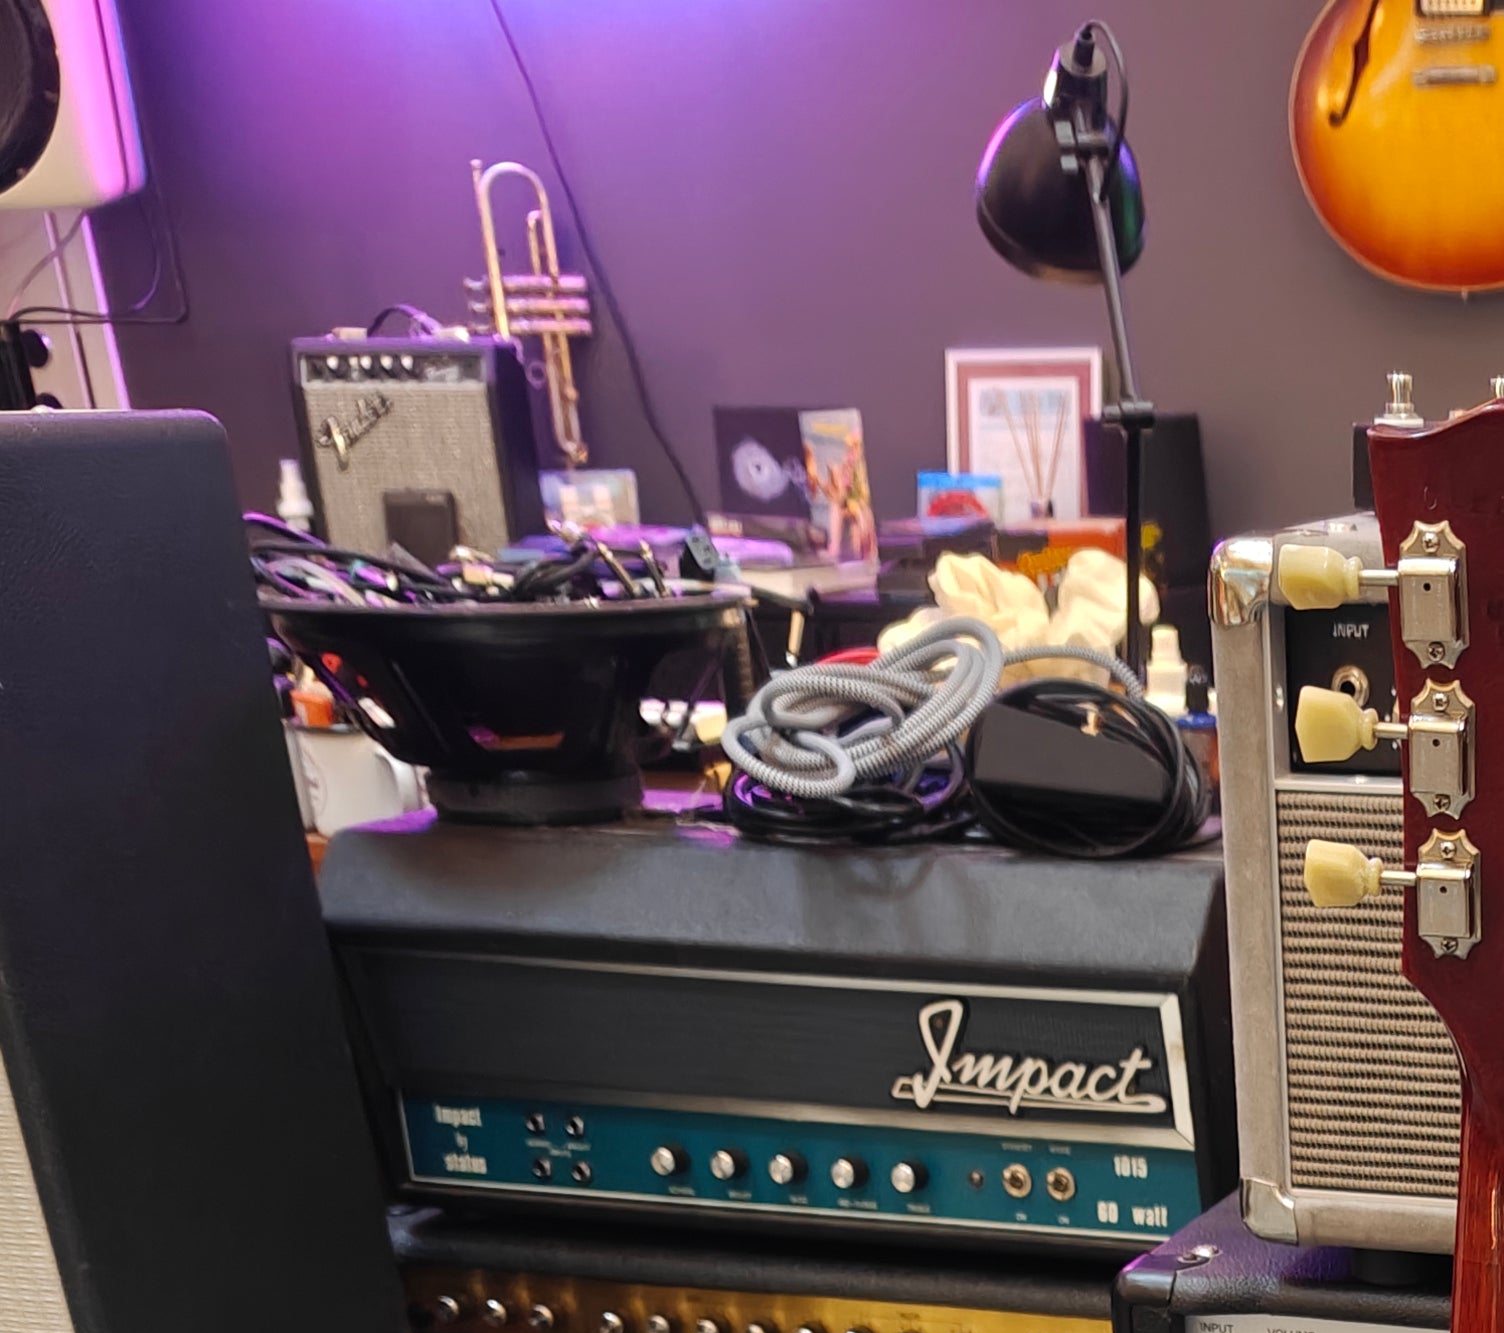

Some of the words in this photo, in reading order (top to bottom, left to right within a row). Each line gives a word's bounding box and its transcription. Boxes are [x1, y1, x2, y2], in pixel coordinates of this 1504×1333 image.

[1332, 623, 1369, 639] INPUT
[891, 1000, 1167, 1114] Impact
[433, 1102, 482, 1129] Impact
[443, 1152, 487, 1175] status
[1096, 1200, 1119, 1225] 60
[1131, 1204, 1168, 1229] watt
